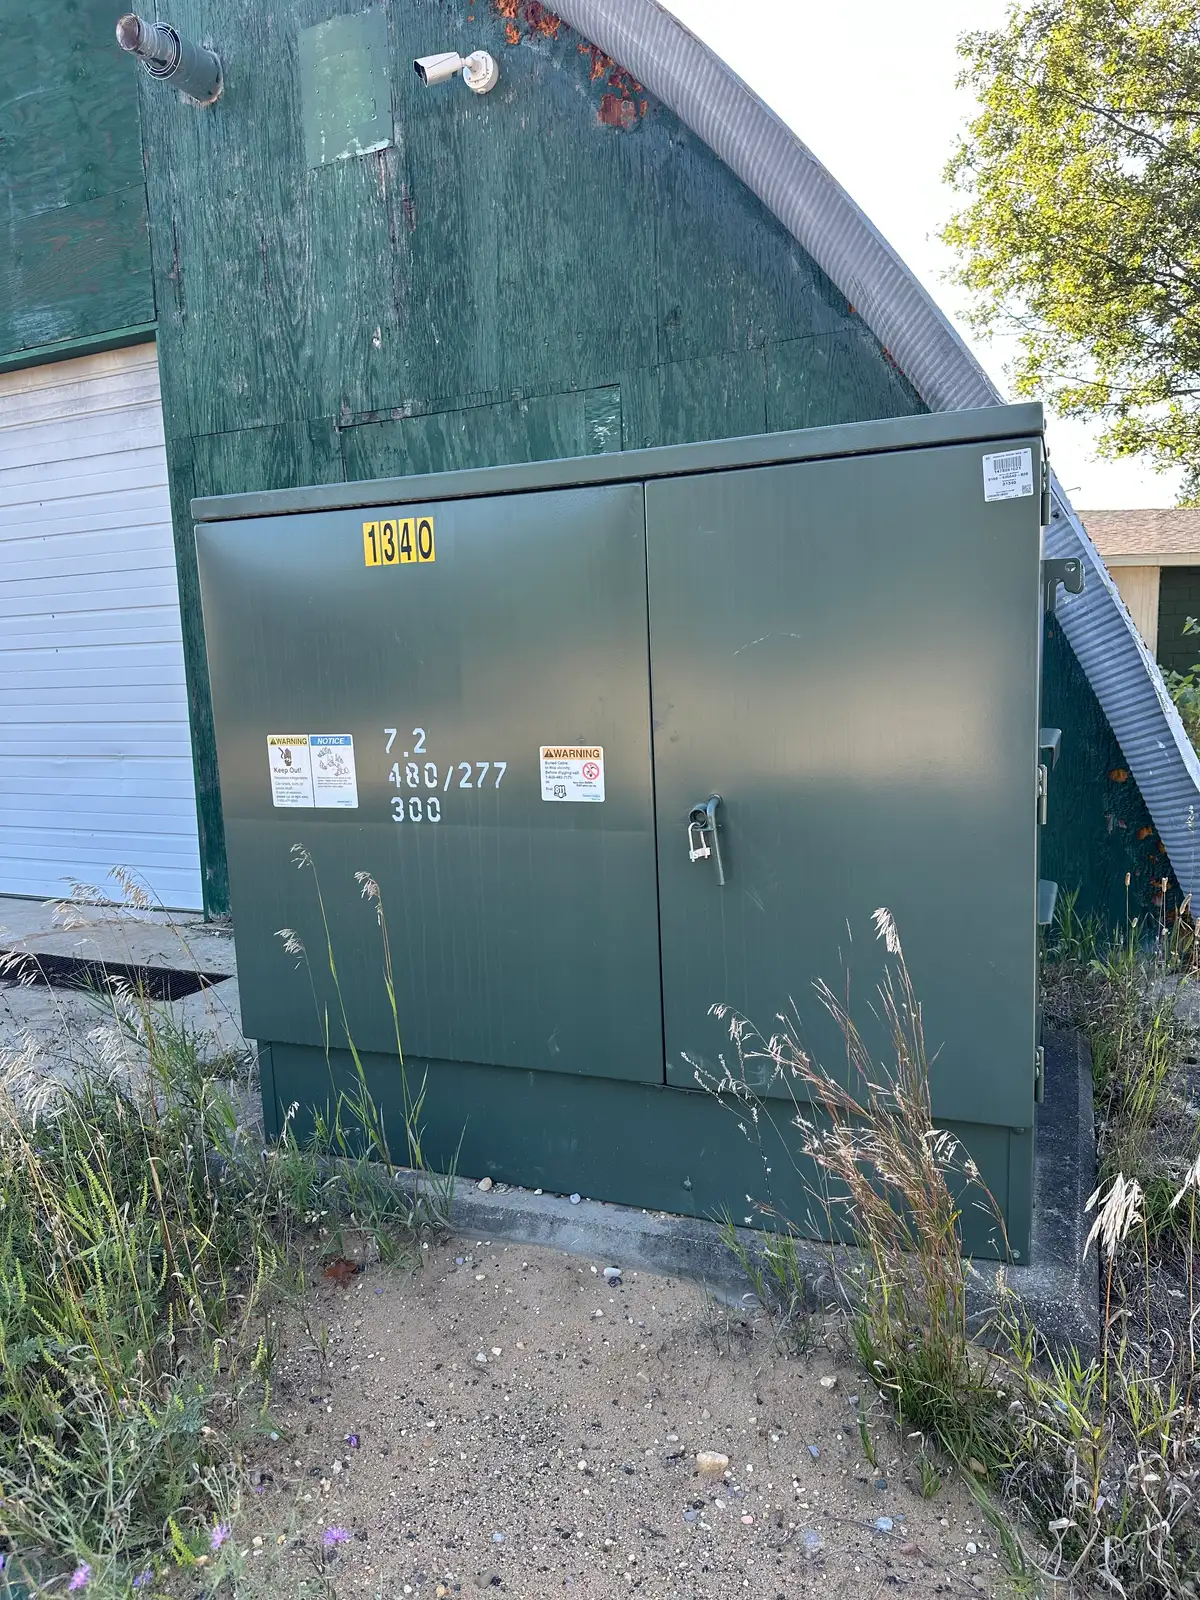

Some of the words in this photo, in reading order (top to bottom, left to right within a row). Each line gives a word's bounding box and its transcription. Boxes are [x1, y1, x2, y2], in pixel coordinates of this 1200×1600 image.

[368, 520, 433, 562] 1340
[384, 728, 427, 757] 7.2
[553, 749, 600, 758] WARNING
[388, 762, 507, 791] 480/277
[390, 797, 441, 822] 300
